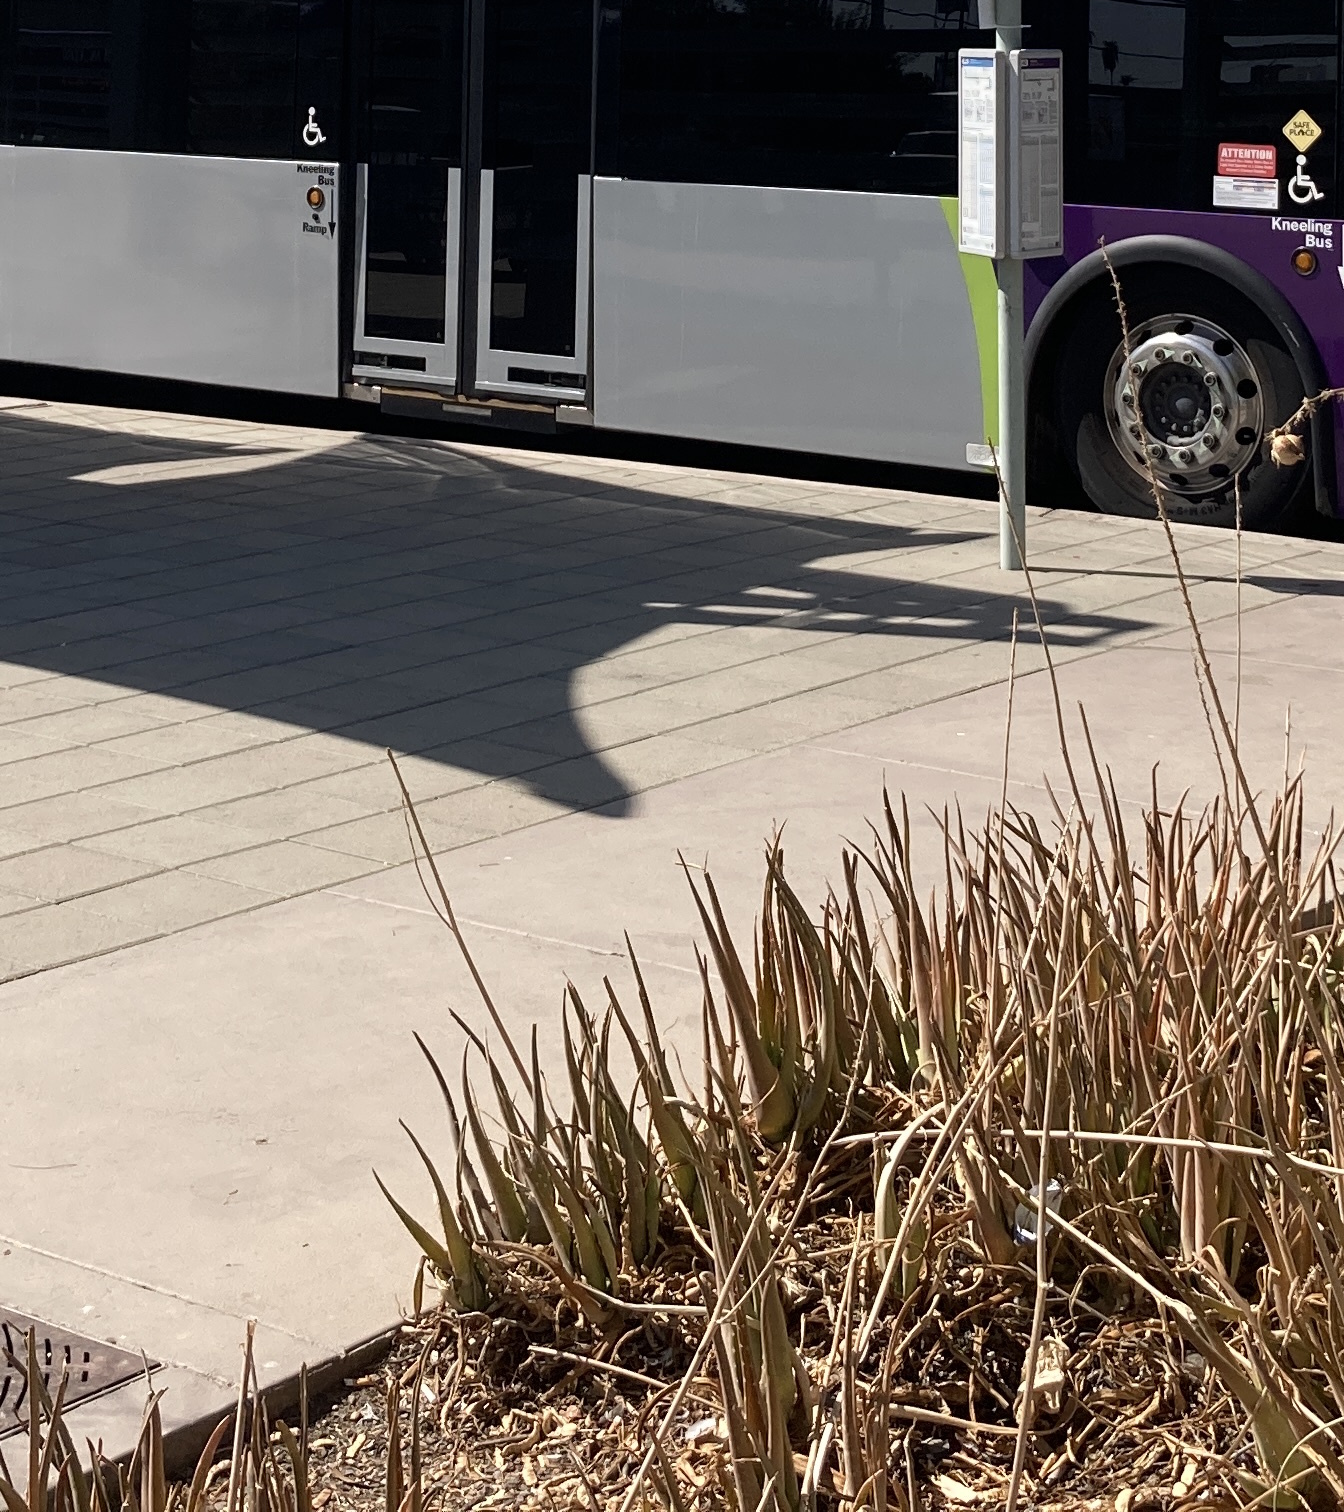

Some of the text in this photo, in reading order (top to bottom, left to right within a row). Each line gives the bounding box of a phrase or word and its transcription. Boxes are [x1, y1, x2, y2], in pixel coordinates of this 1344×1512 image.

[1293, 121, 1310, 129] SAFE
[1221, 147, 1273, 160] ATTENTION
[296, 163, 335, 176] Kneeling
[317, 175, 335, 186] Bus
[302, 221, 328, 235] Ramp
[1271, 216, 1333, 236] Kneeling
[1305, 233, 1333, 248] Bus
